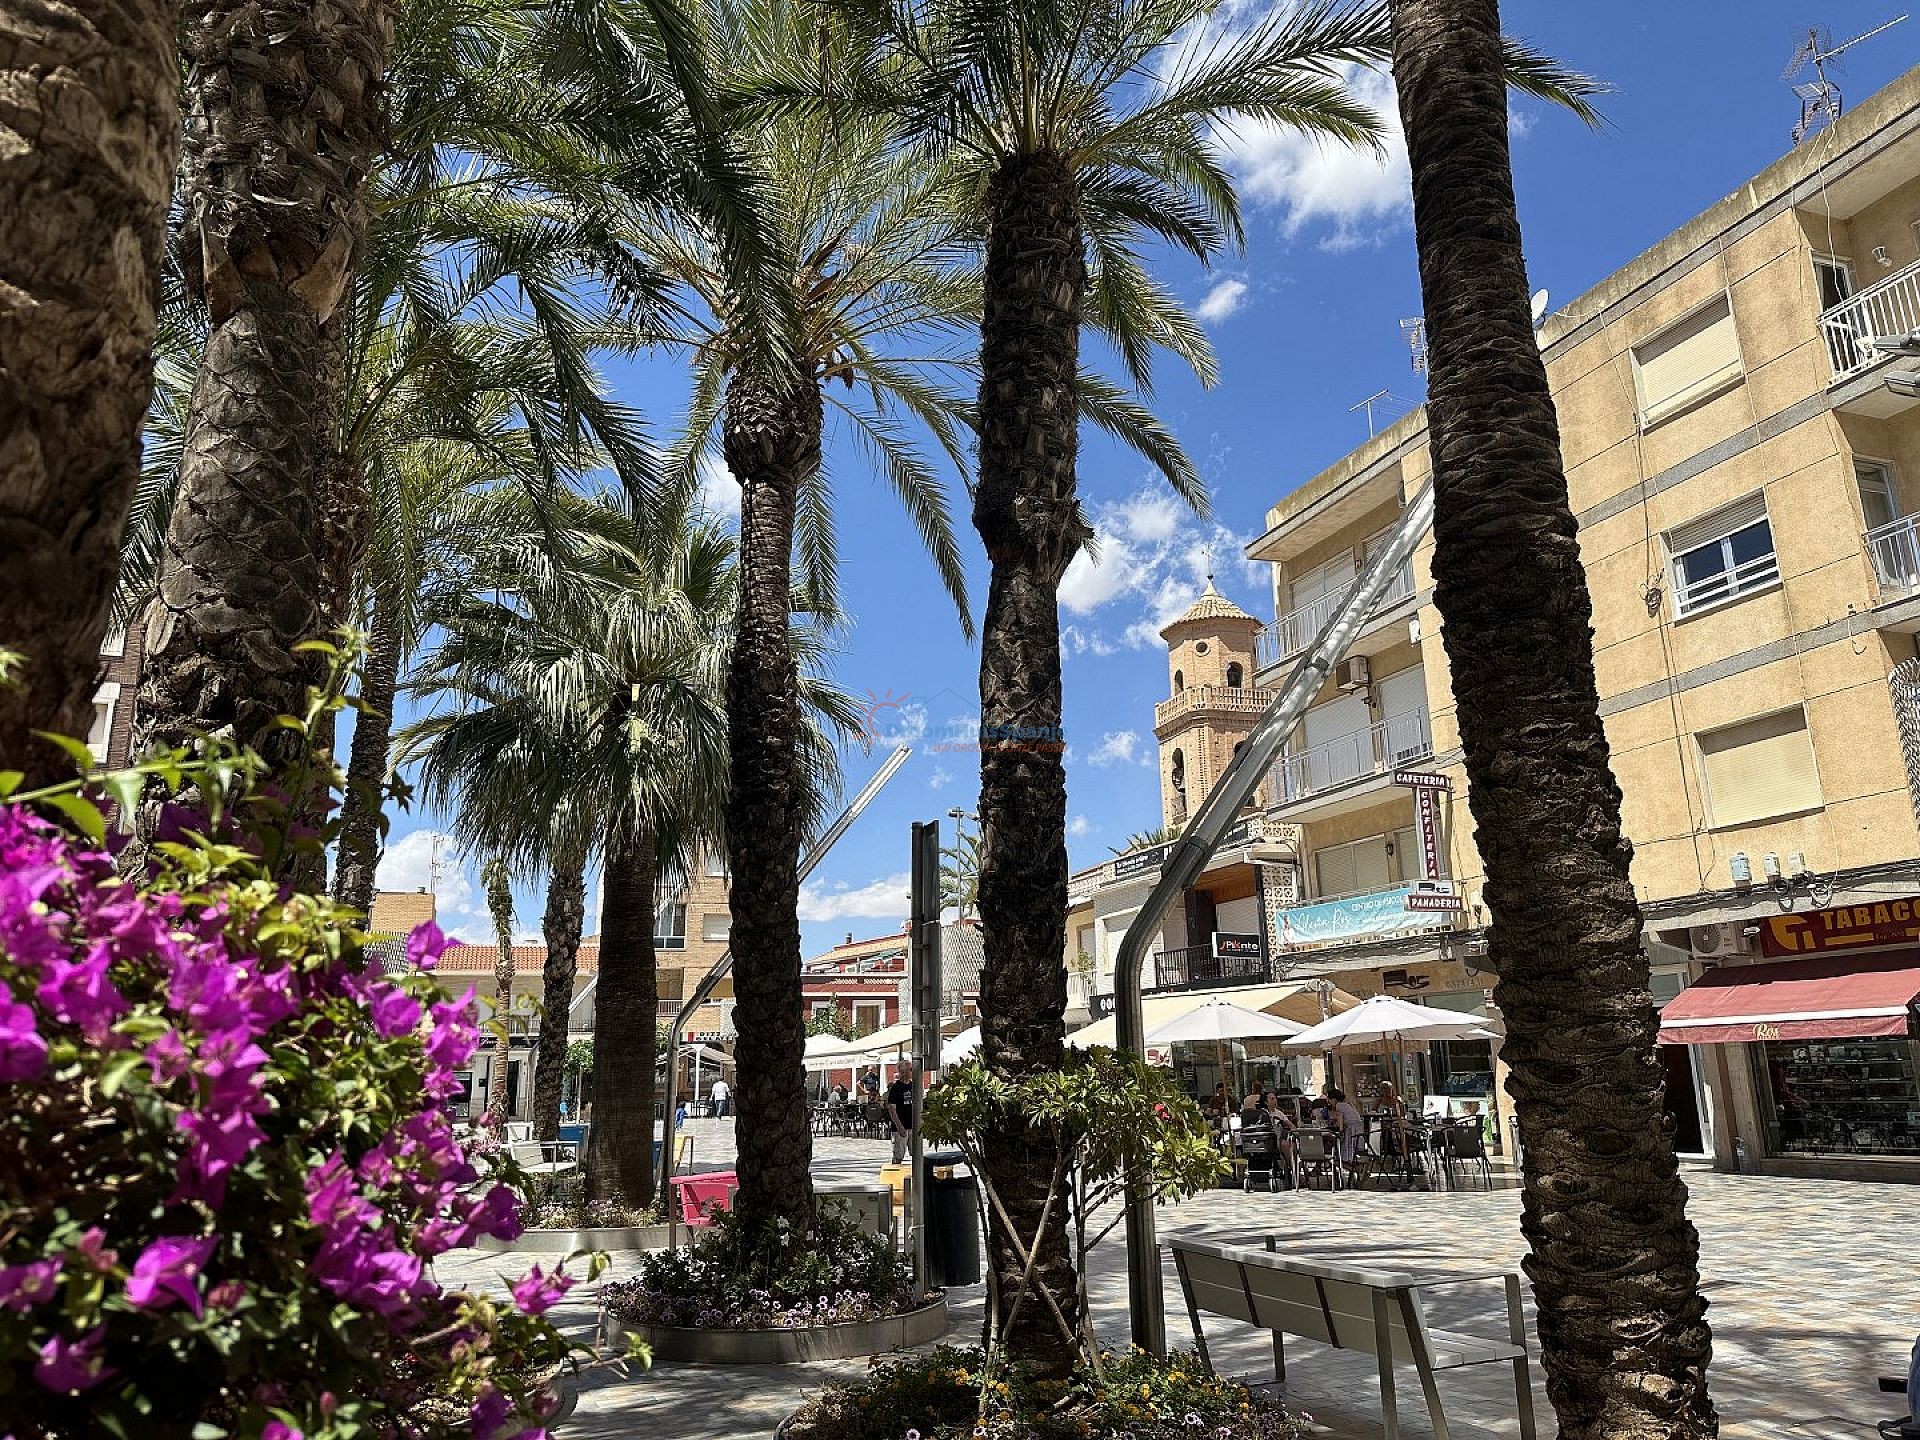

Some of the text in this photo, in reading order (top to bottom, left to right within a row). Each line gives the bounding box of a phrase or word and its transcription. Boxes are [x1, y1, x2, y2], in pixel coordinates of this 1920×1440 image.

[1396, 773, 1446, 786] CAFETERIA
[1420, 790, 1437, 878] CONFITERIA
[1411, 897, 1461, 909] PANADERIA
